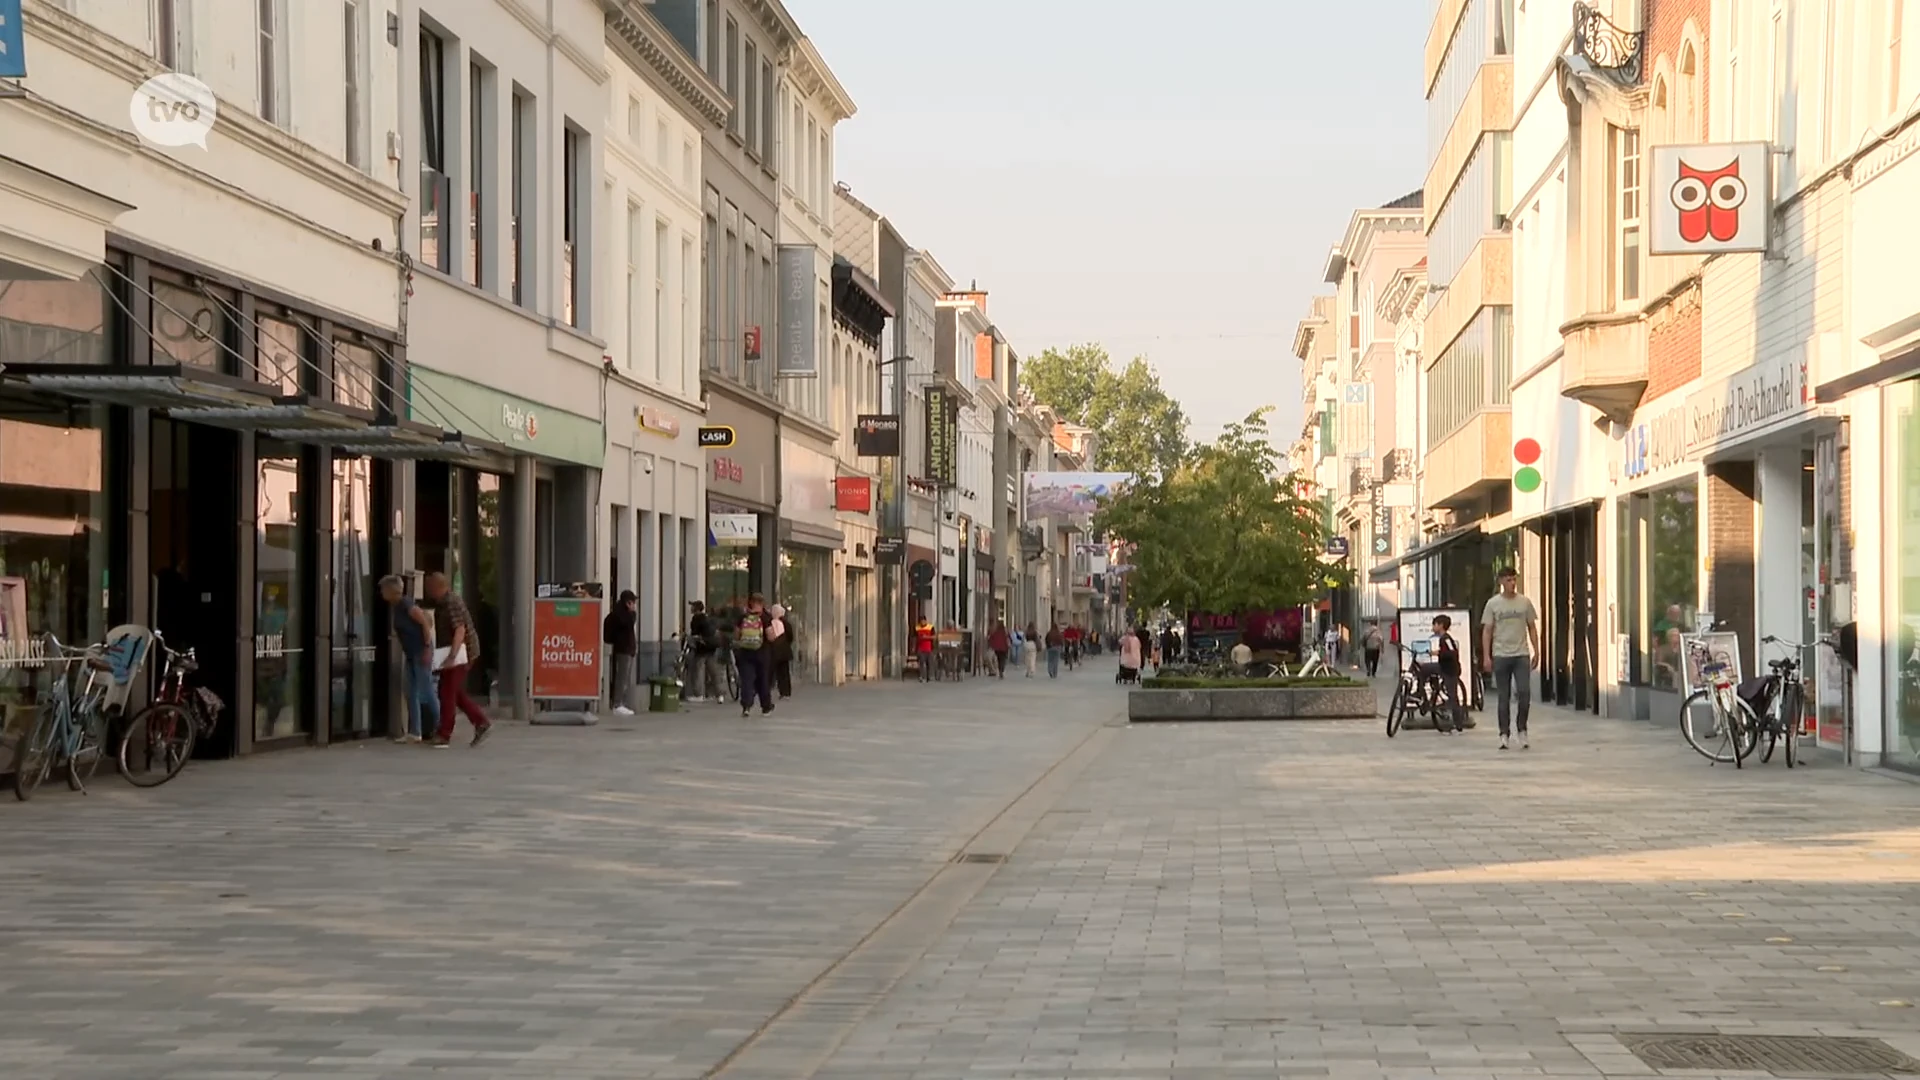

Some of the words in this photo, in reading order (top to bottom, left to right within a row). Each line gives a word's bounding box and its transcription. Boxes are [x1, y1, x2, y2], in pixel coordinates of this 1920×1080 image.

[1693, 389, 1735, 445] Standaard
[1737, 363, 1794, 428] Boekhandel
[701, 432, 726, 442] CASH
[930, 391, 942, 478] DRUKPUNT
[838, 487, 868, 495] VIONIC
[1375, 487, 1384, 534] BRAND
[542, 635, 574, 649] 40%
